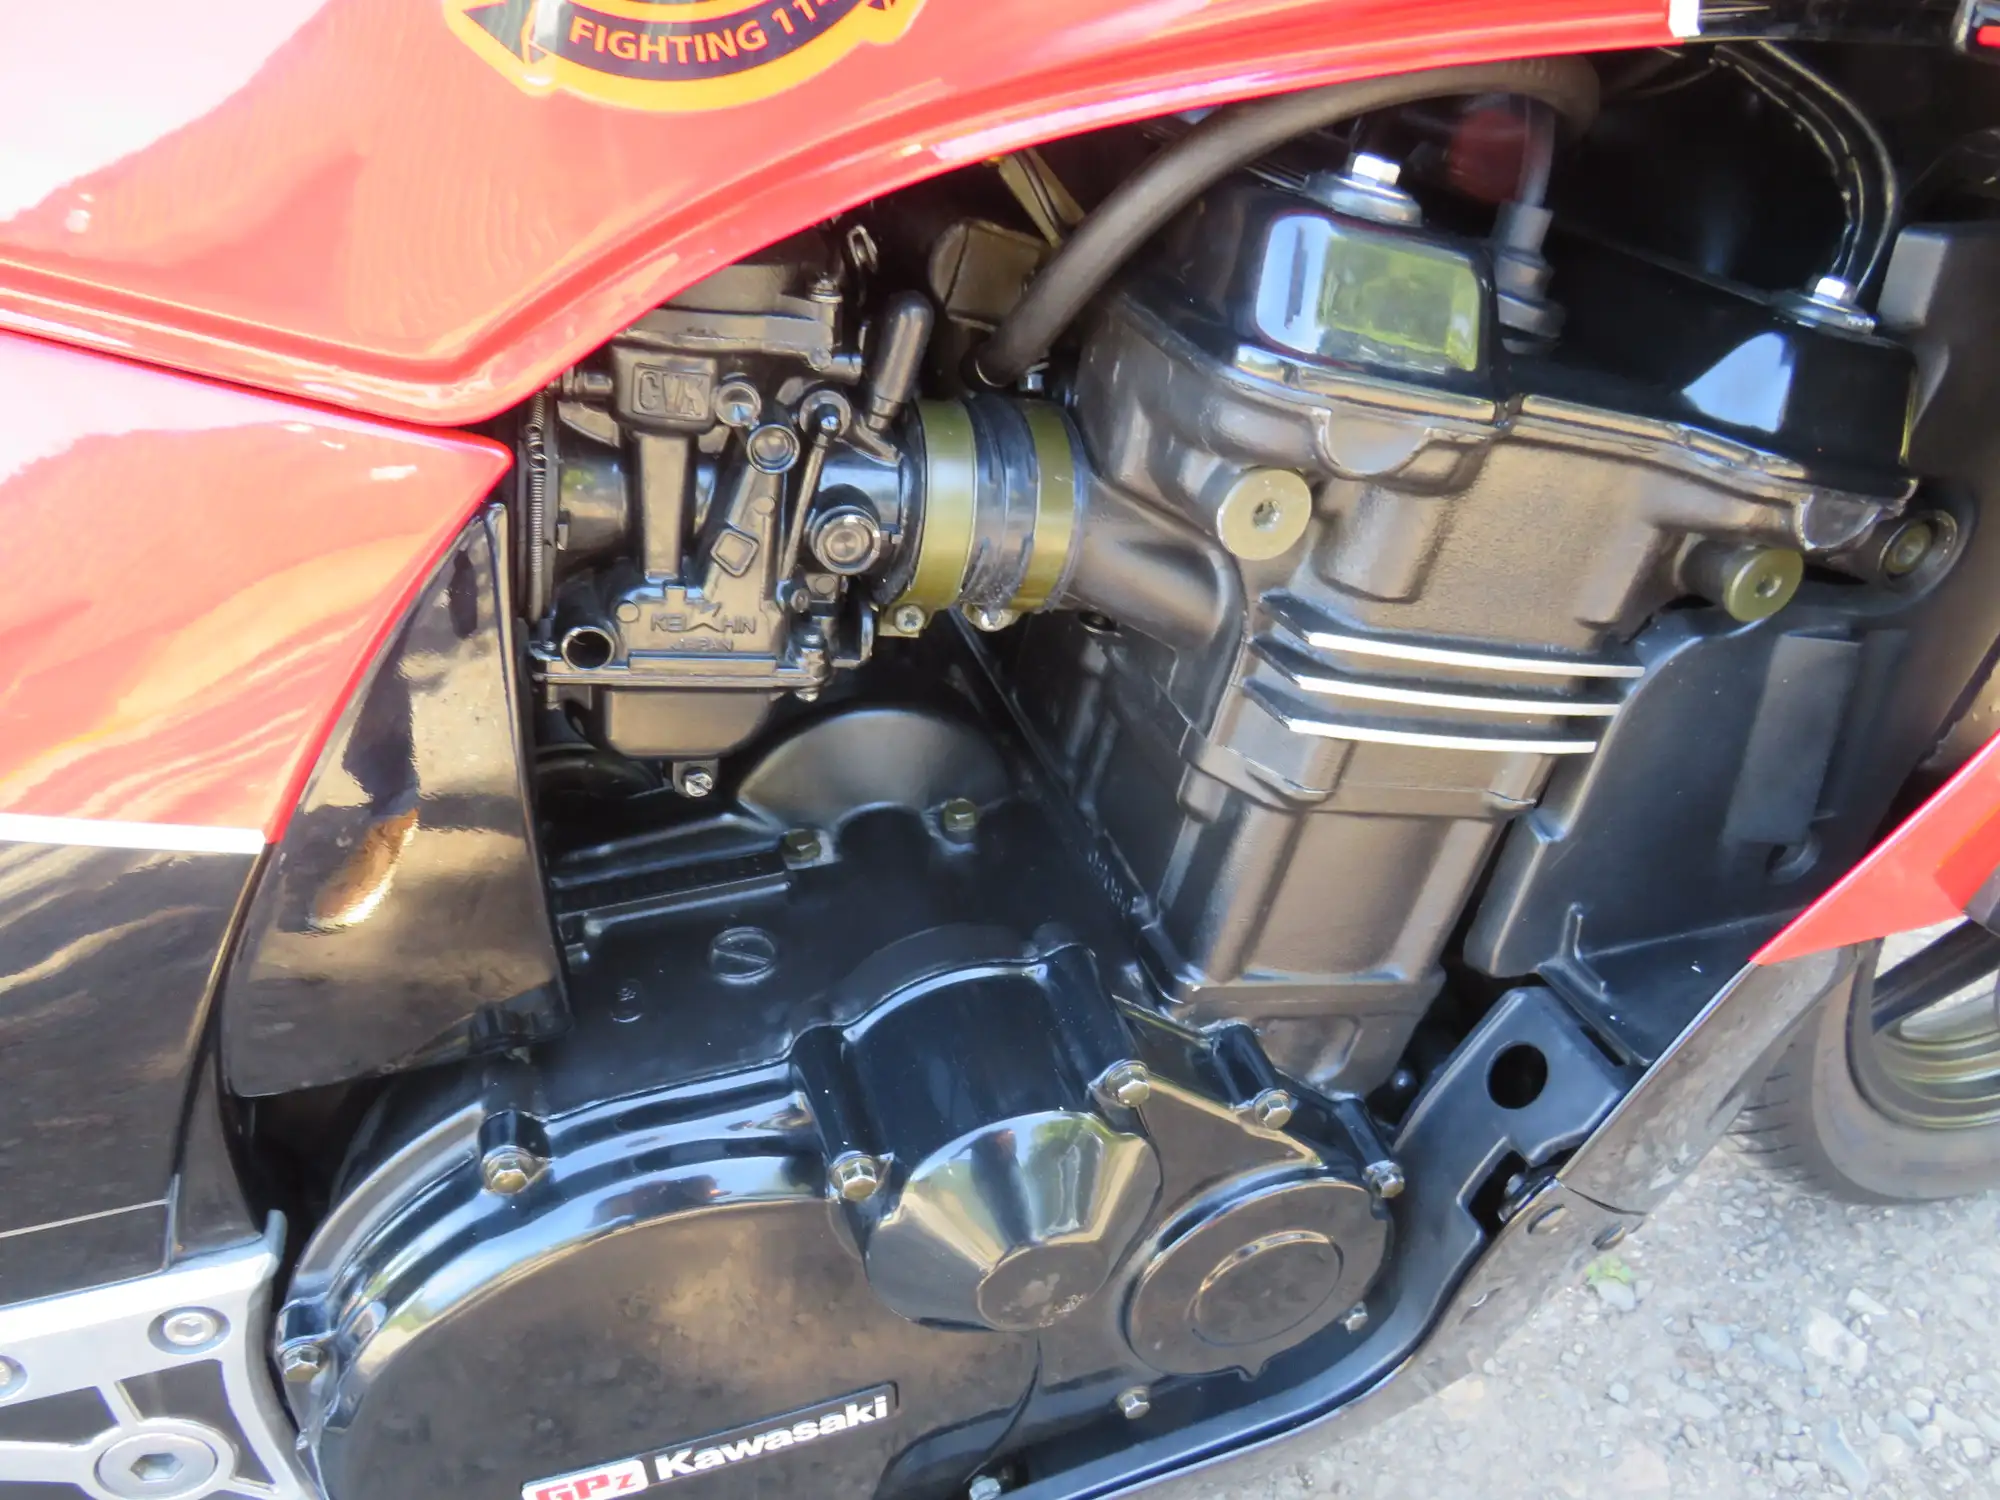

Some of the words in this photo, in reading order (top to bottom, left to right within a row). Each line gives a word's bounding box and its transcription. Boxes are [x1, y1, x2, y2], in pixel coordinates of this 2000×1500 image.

[568, 15, 768, 64] FIGHTING
[771, 0, 838, 35] 11
[654, 1395, 888, 1480] Kawasaki
